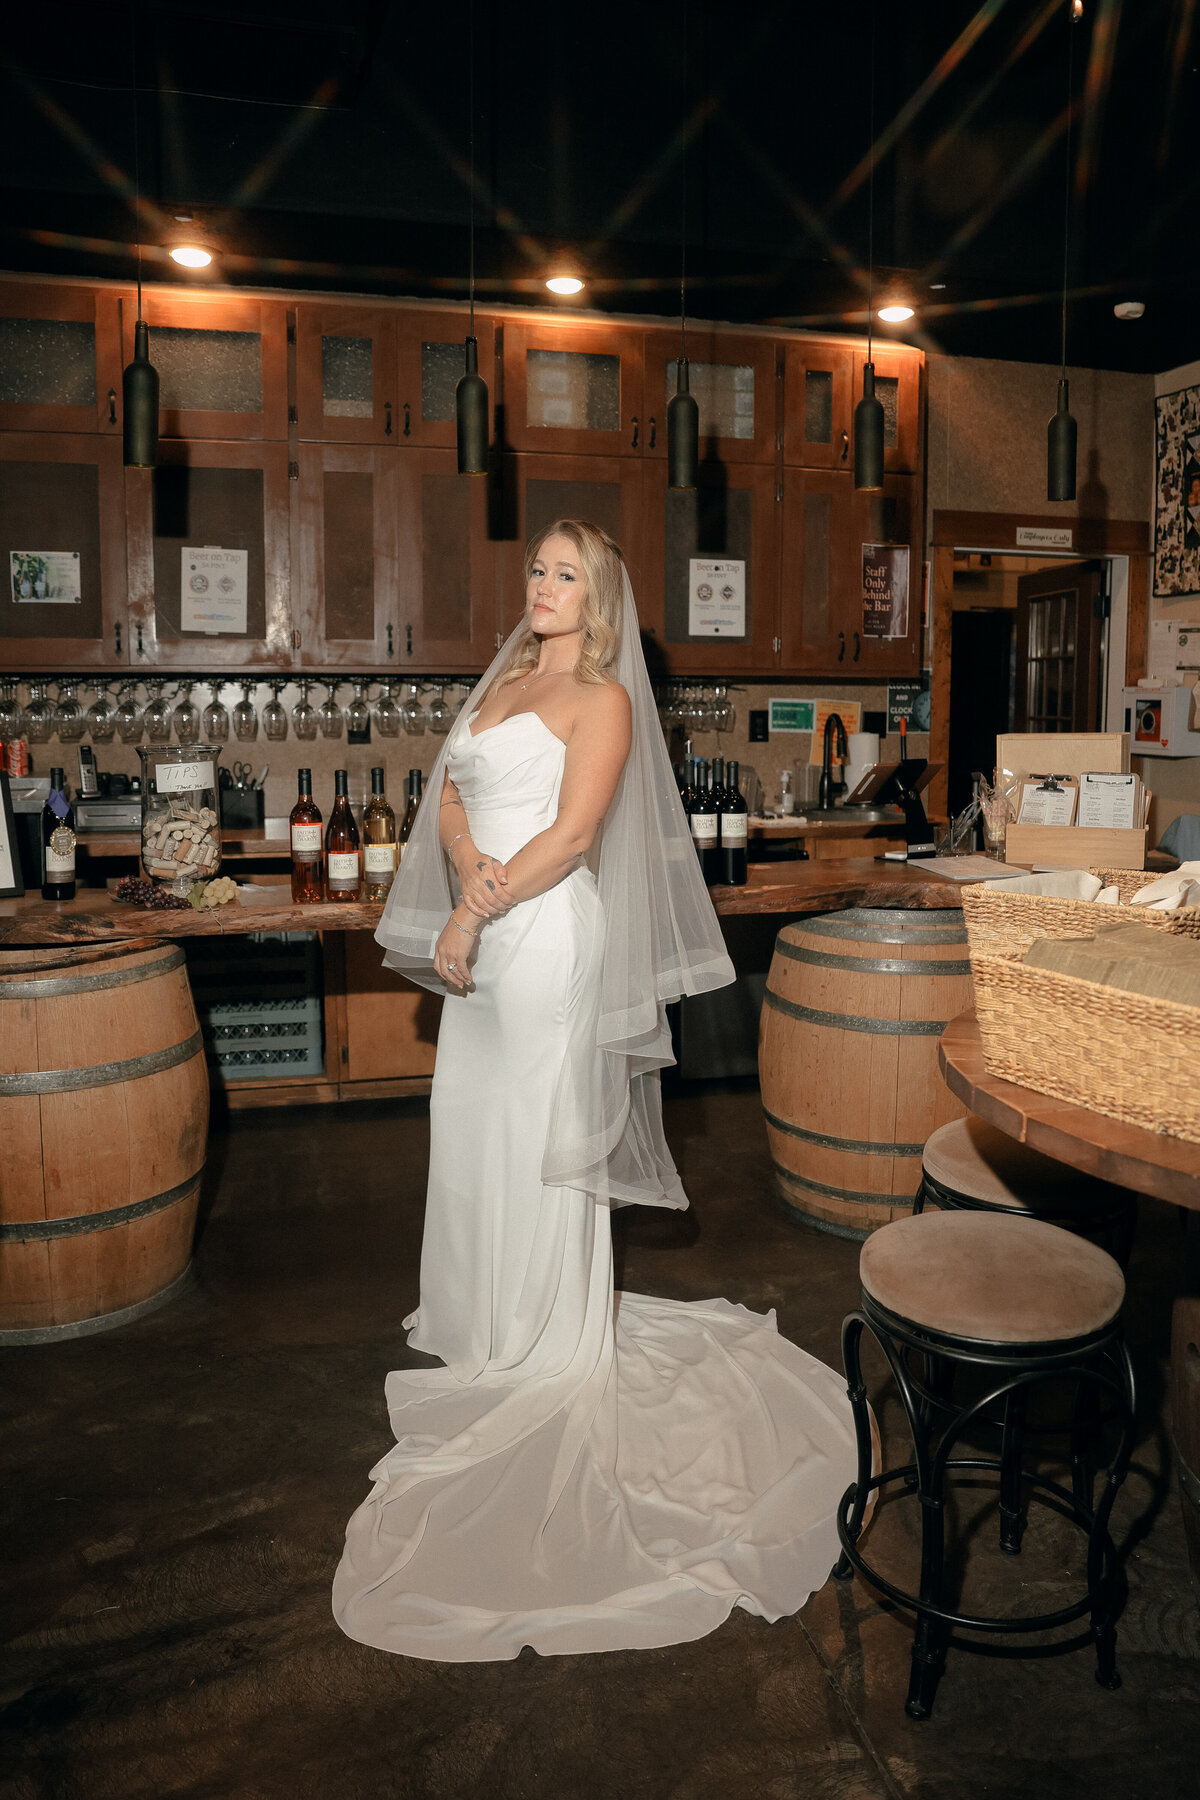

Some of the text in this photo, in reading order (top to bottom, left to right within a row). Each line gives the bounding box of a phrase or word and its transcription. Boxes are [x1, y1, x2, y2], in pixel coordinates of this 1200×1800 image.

[189, 551, 208, 561] Beer
[224, 553, 241, 565] Tap
[697, 562, 713, 571] Beer
[726, 563, 740, 574] Tap
[865, 565, 887, 577] Staff
[865, 577, 886, 591] Only
[864, 600, 891, 611] he Bar
[890, 706, 912, 714] CLOCK
[163, 764, 198, 780] TIPS
